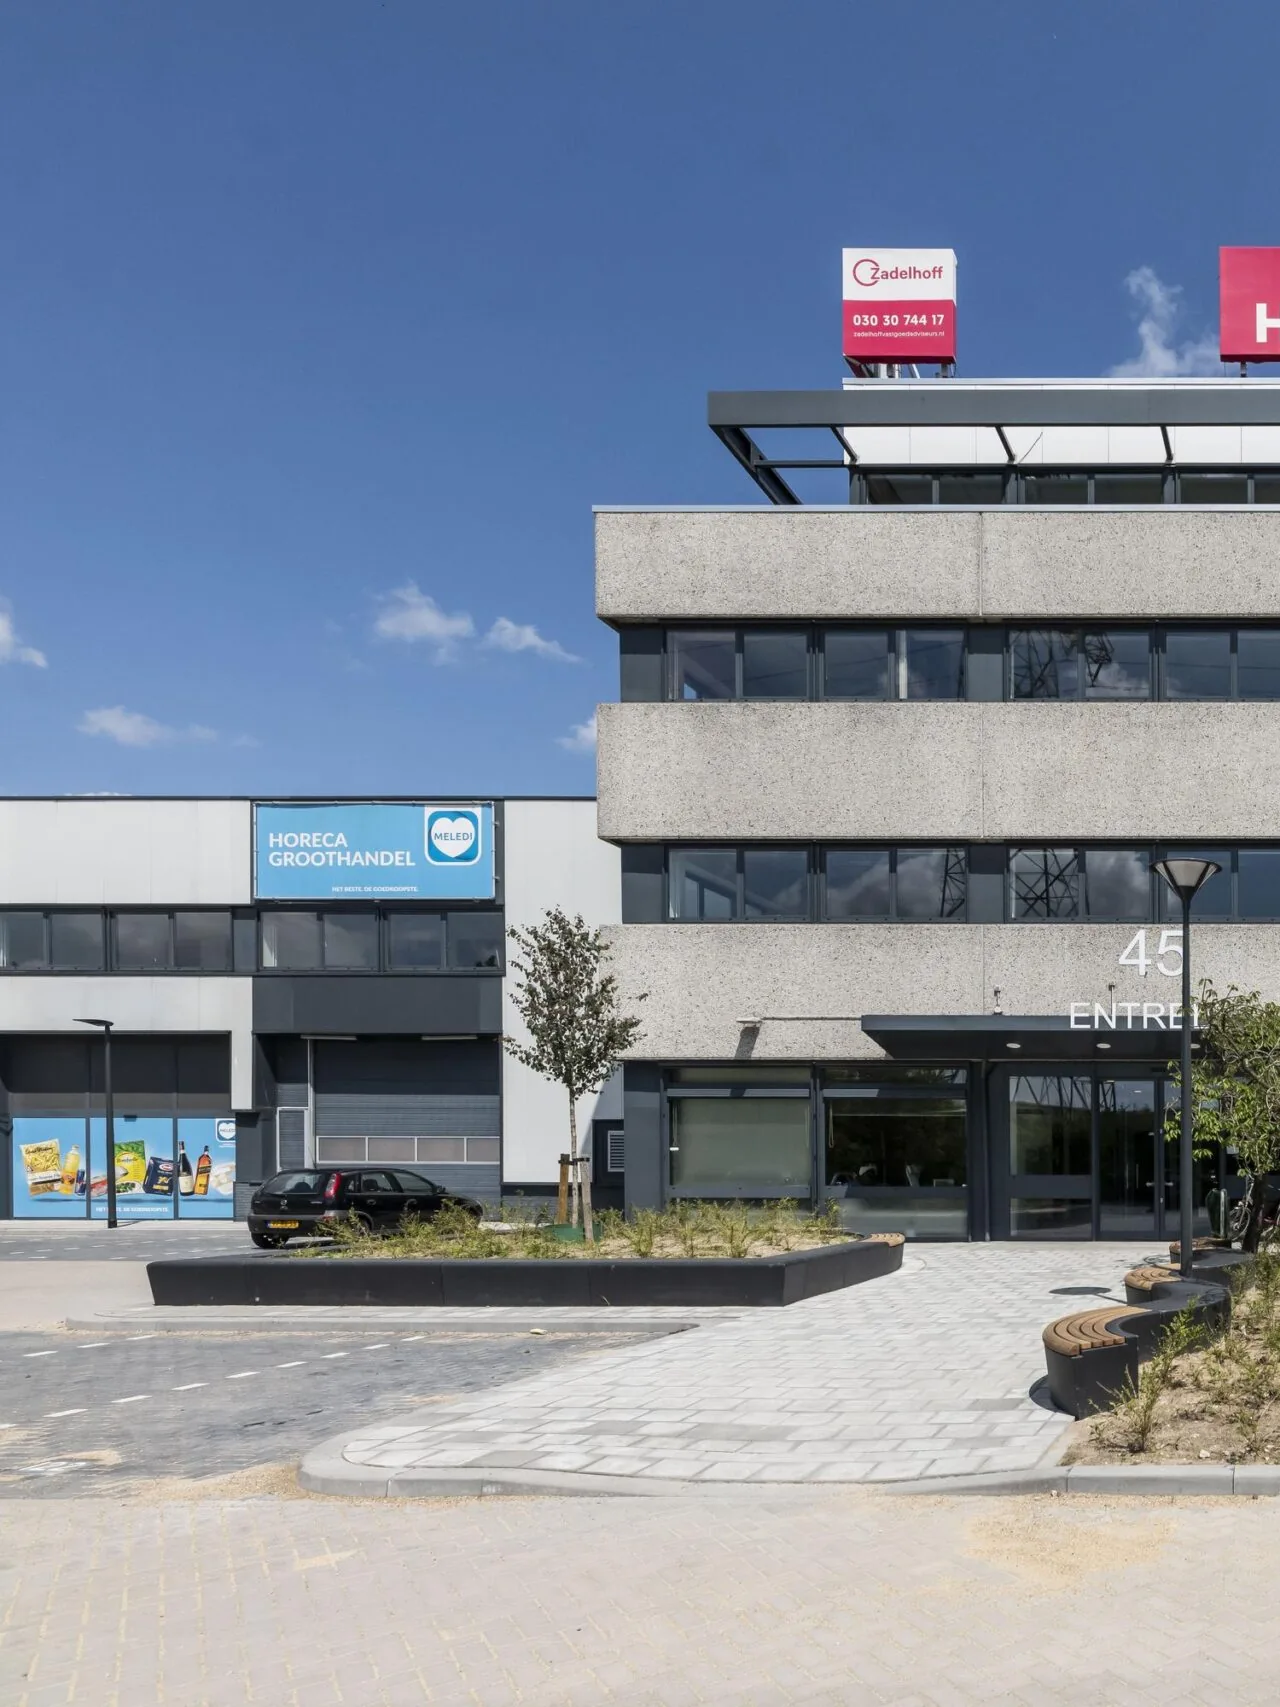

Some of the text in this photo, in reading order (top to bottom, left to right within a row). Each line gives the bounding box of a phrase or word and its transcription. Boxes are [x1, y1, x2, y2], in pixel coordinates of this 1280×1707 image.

[870, 265, 943, 280] Zadelhoff
[852, 314, 945, 326] 030 30 744 17
[268, 832, 348, 848] HORECA
[433, 832, 473, 841] MELEDI
[268, 851, 416, 867] GROOTHANDEL
[1118, 929, 1184, 977] 45
